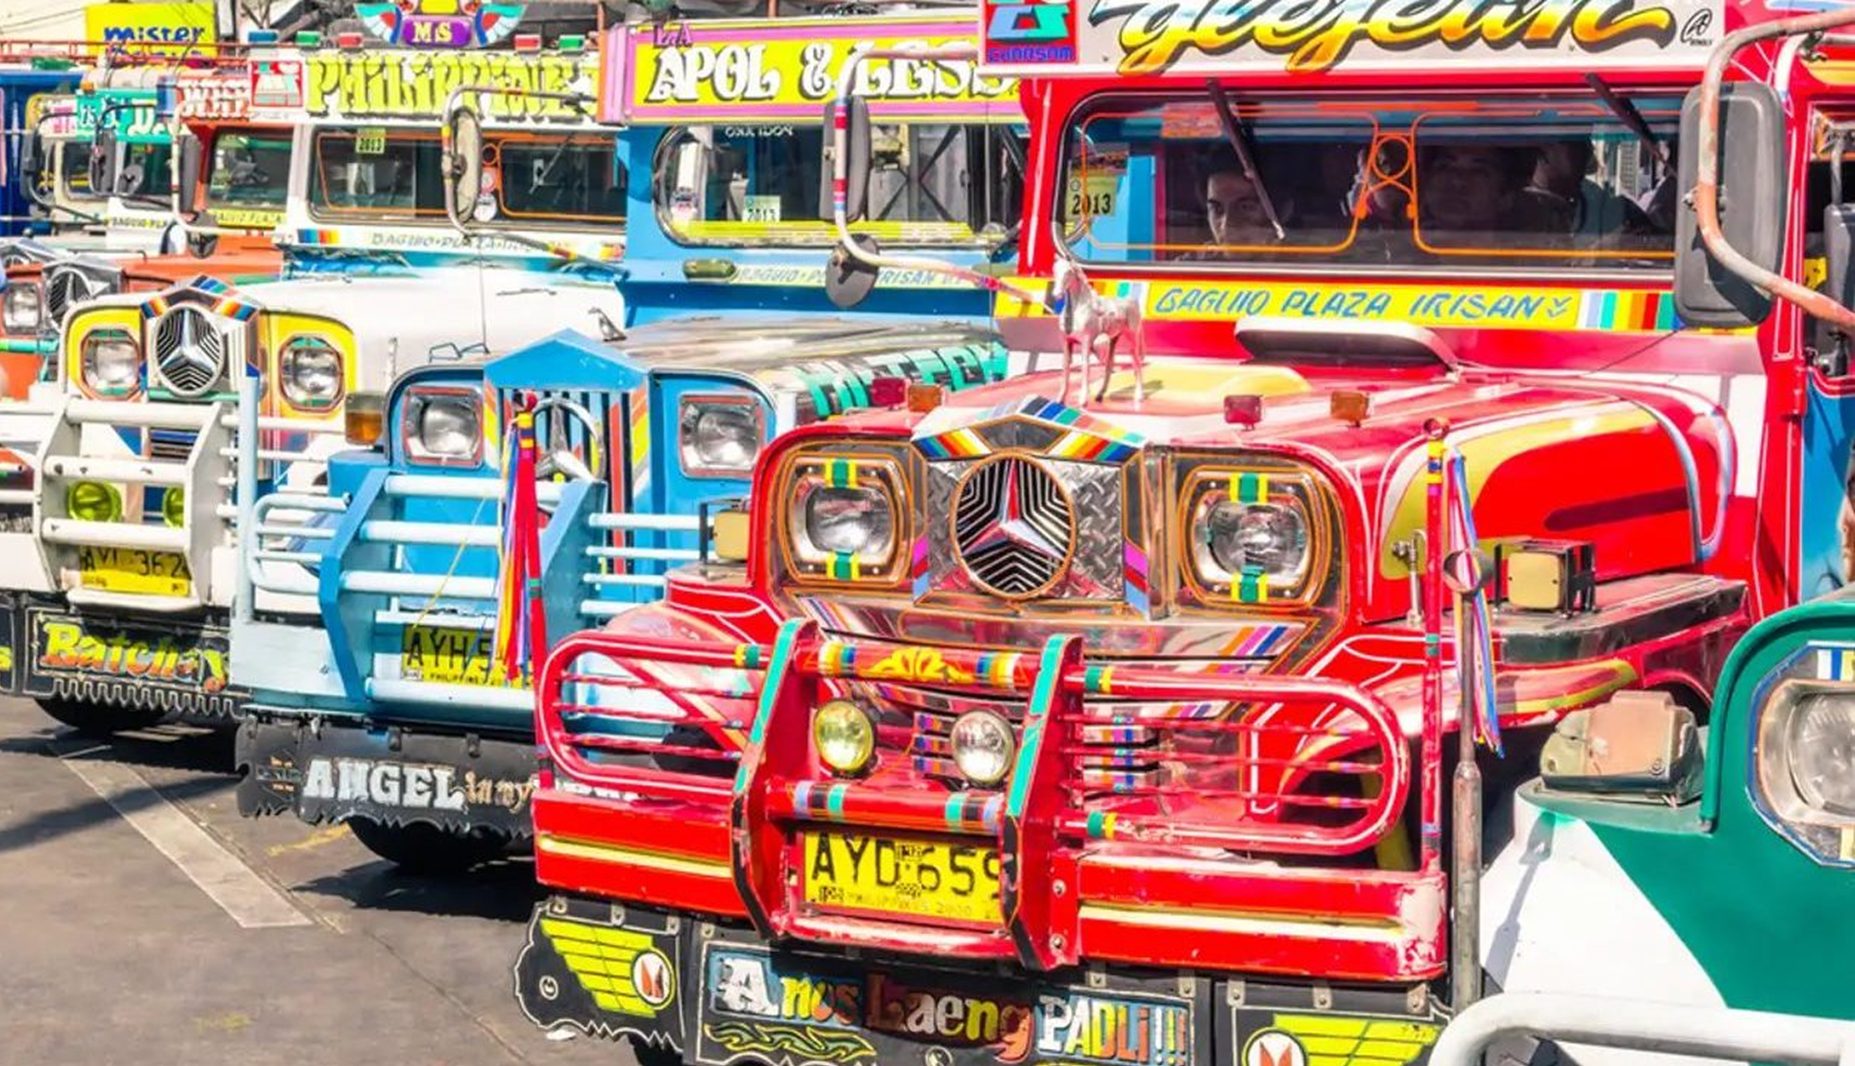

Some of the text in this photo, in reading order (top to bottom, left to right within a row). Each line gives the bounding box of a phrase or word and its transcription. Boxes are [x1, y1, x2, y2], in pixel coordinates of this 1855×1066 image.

[104, 26, 204, 42] mister
[644, 44, 781, 102] APOL
[1071, 193, 1112, 215] 2013
[1155, 287, 1271, 316] BAGUIO
[1280, 290, 1392, 318] PLAZA
[1409, 293, 1546, 320] IRISAN
[406, 630, 468, 671] AYH
[303, 757, 465, 812] ANGEL
[812, 832, 901, 887] AYD
[717, 957, 861, 1026] Anos
[867, 971, 1036, 1064] Laeng
